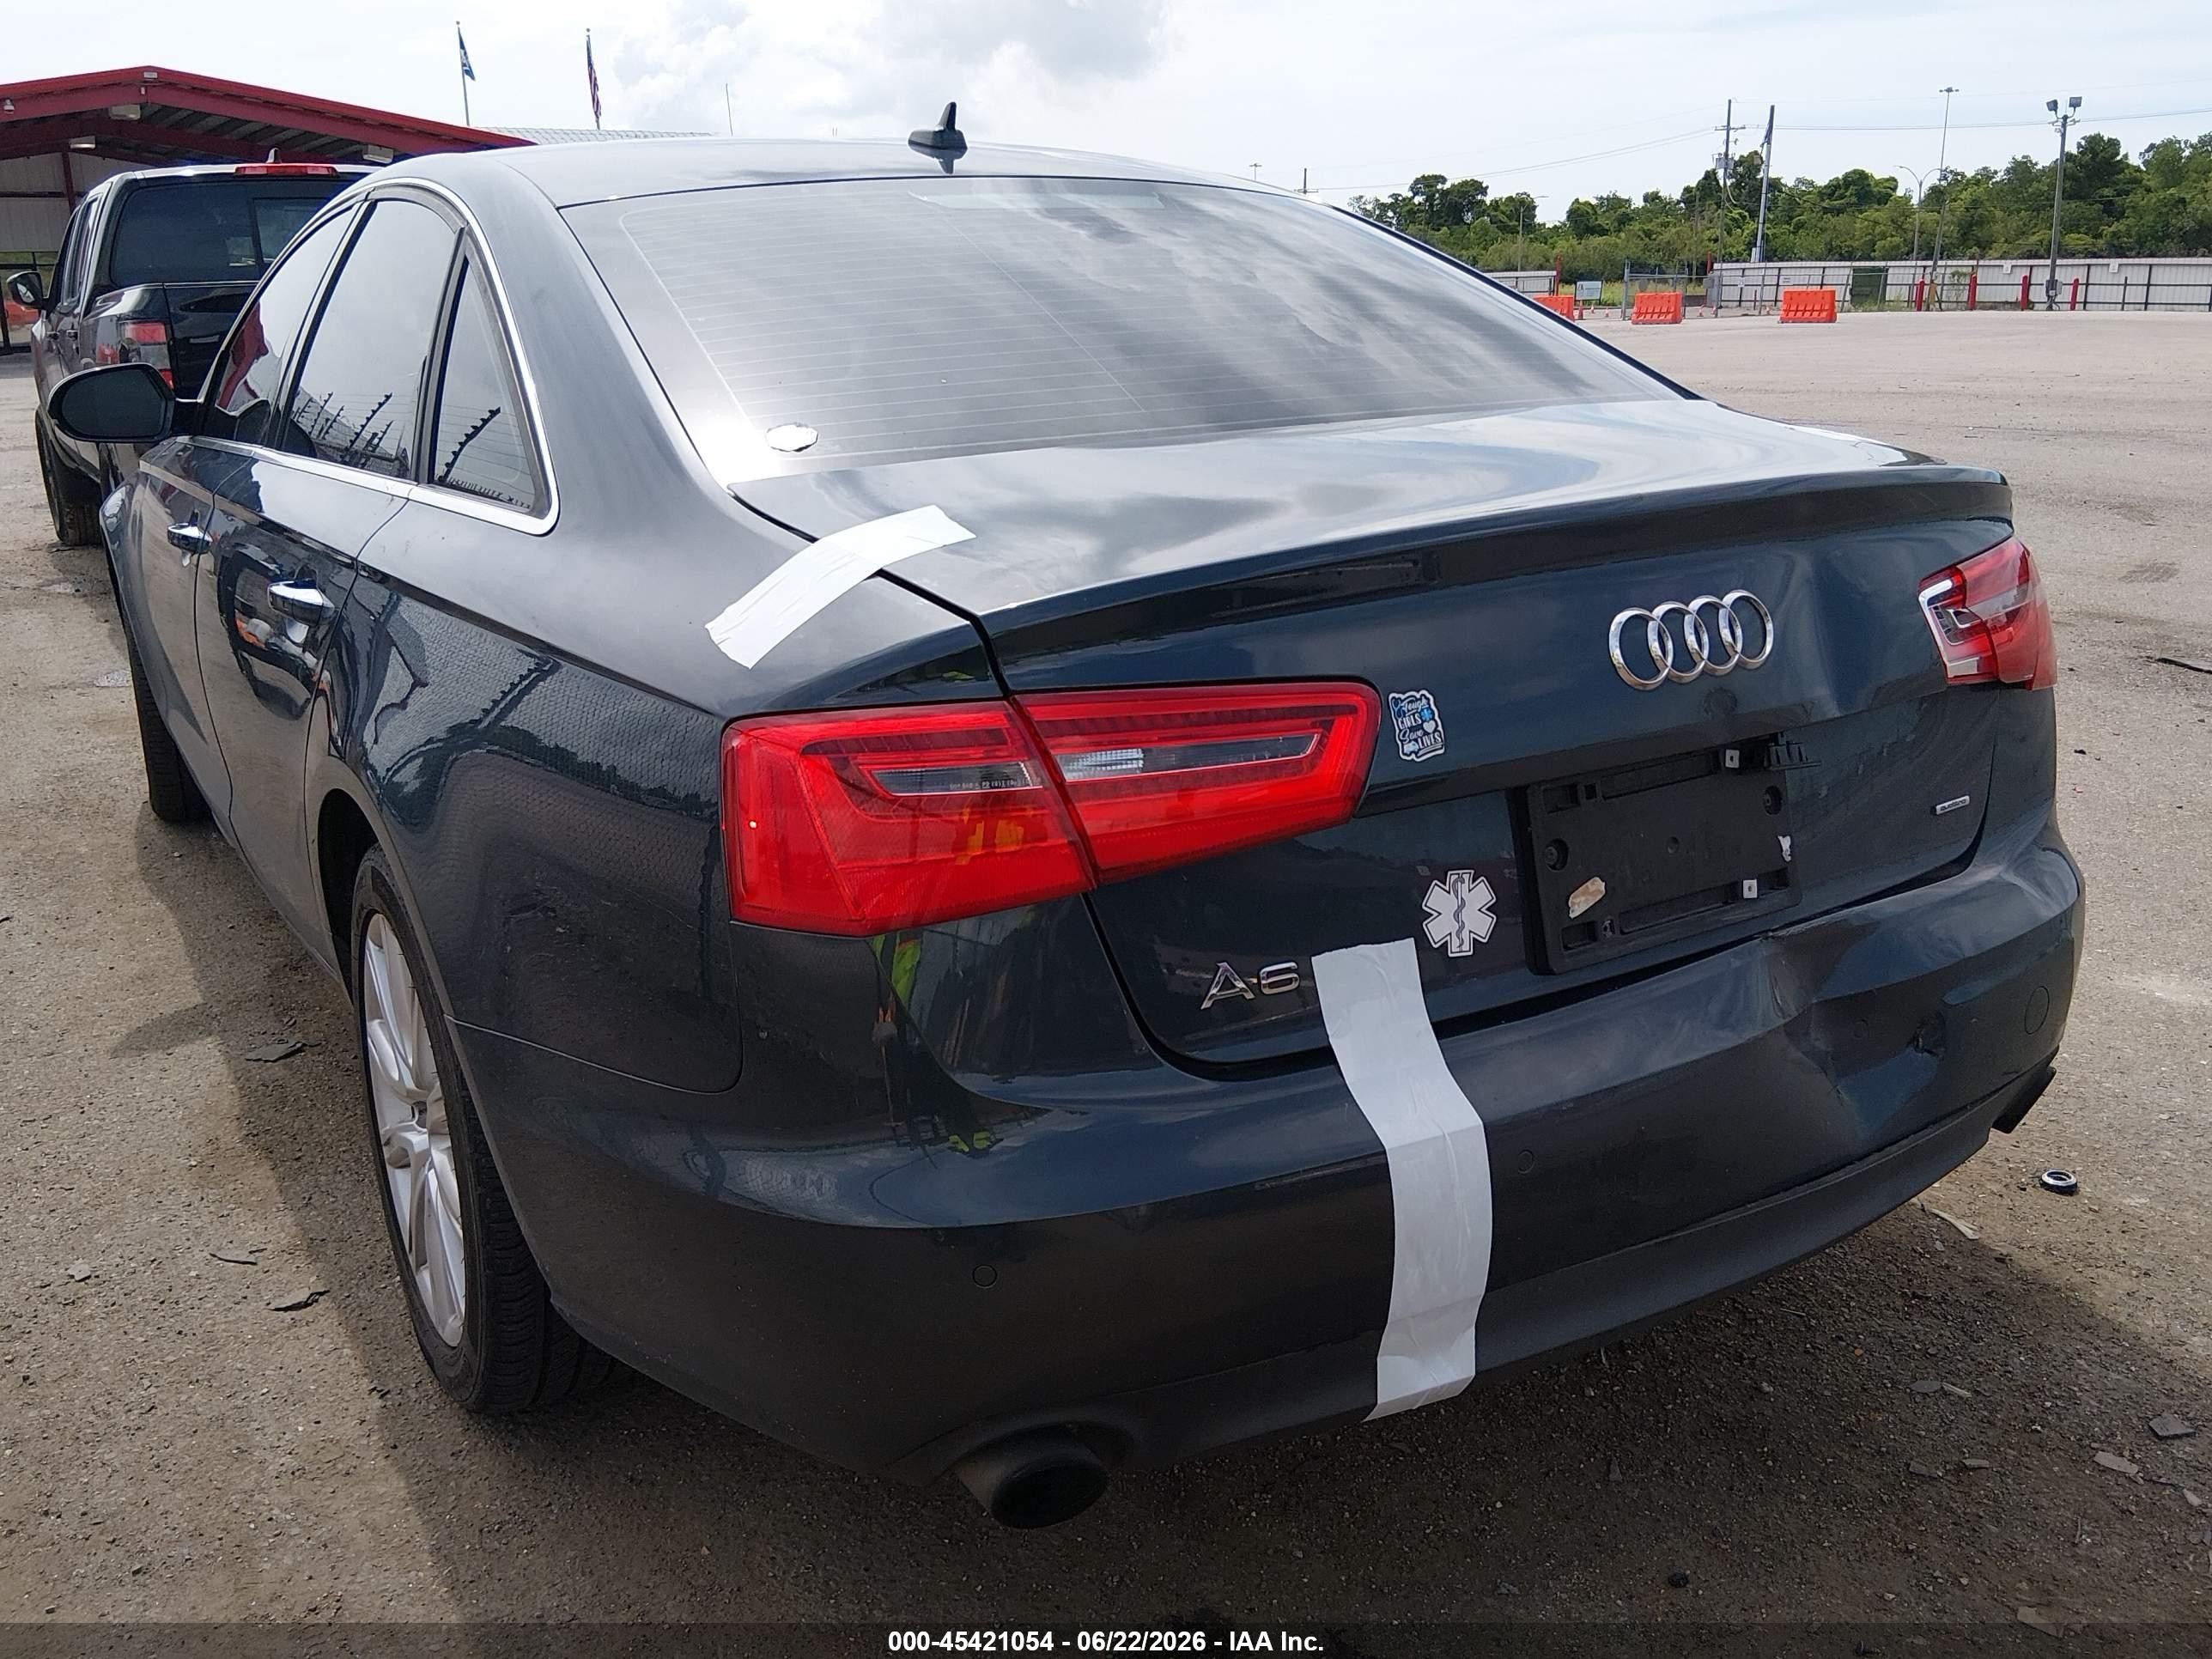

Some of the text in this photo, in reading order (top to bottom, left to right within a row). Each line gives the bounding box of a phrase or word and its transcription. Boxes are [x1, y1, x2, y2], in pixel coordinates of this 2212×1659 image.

[1398, 714, 1422, 729] GIRLS
[1400, 728, 1424, 744] Save
[1418, 732, 1442, 749] LIVES
[1200, 962, 1300, 1009] A6
